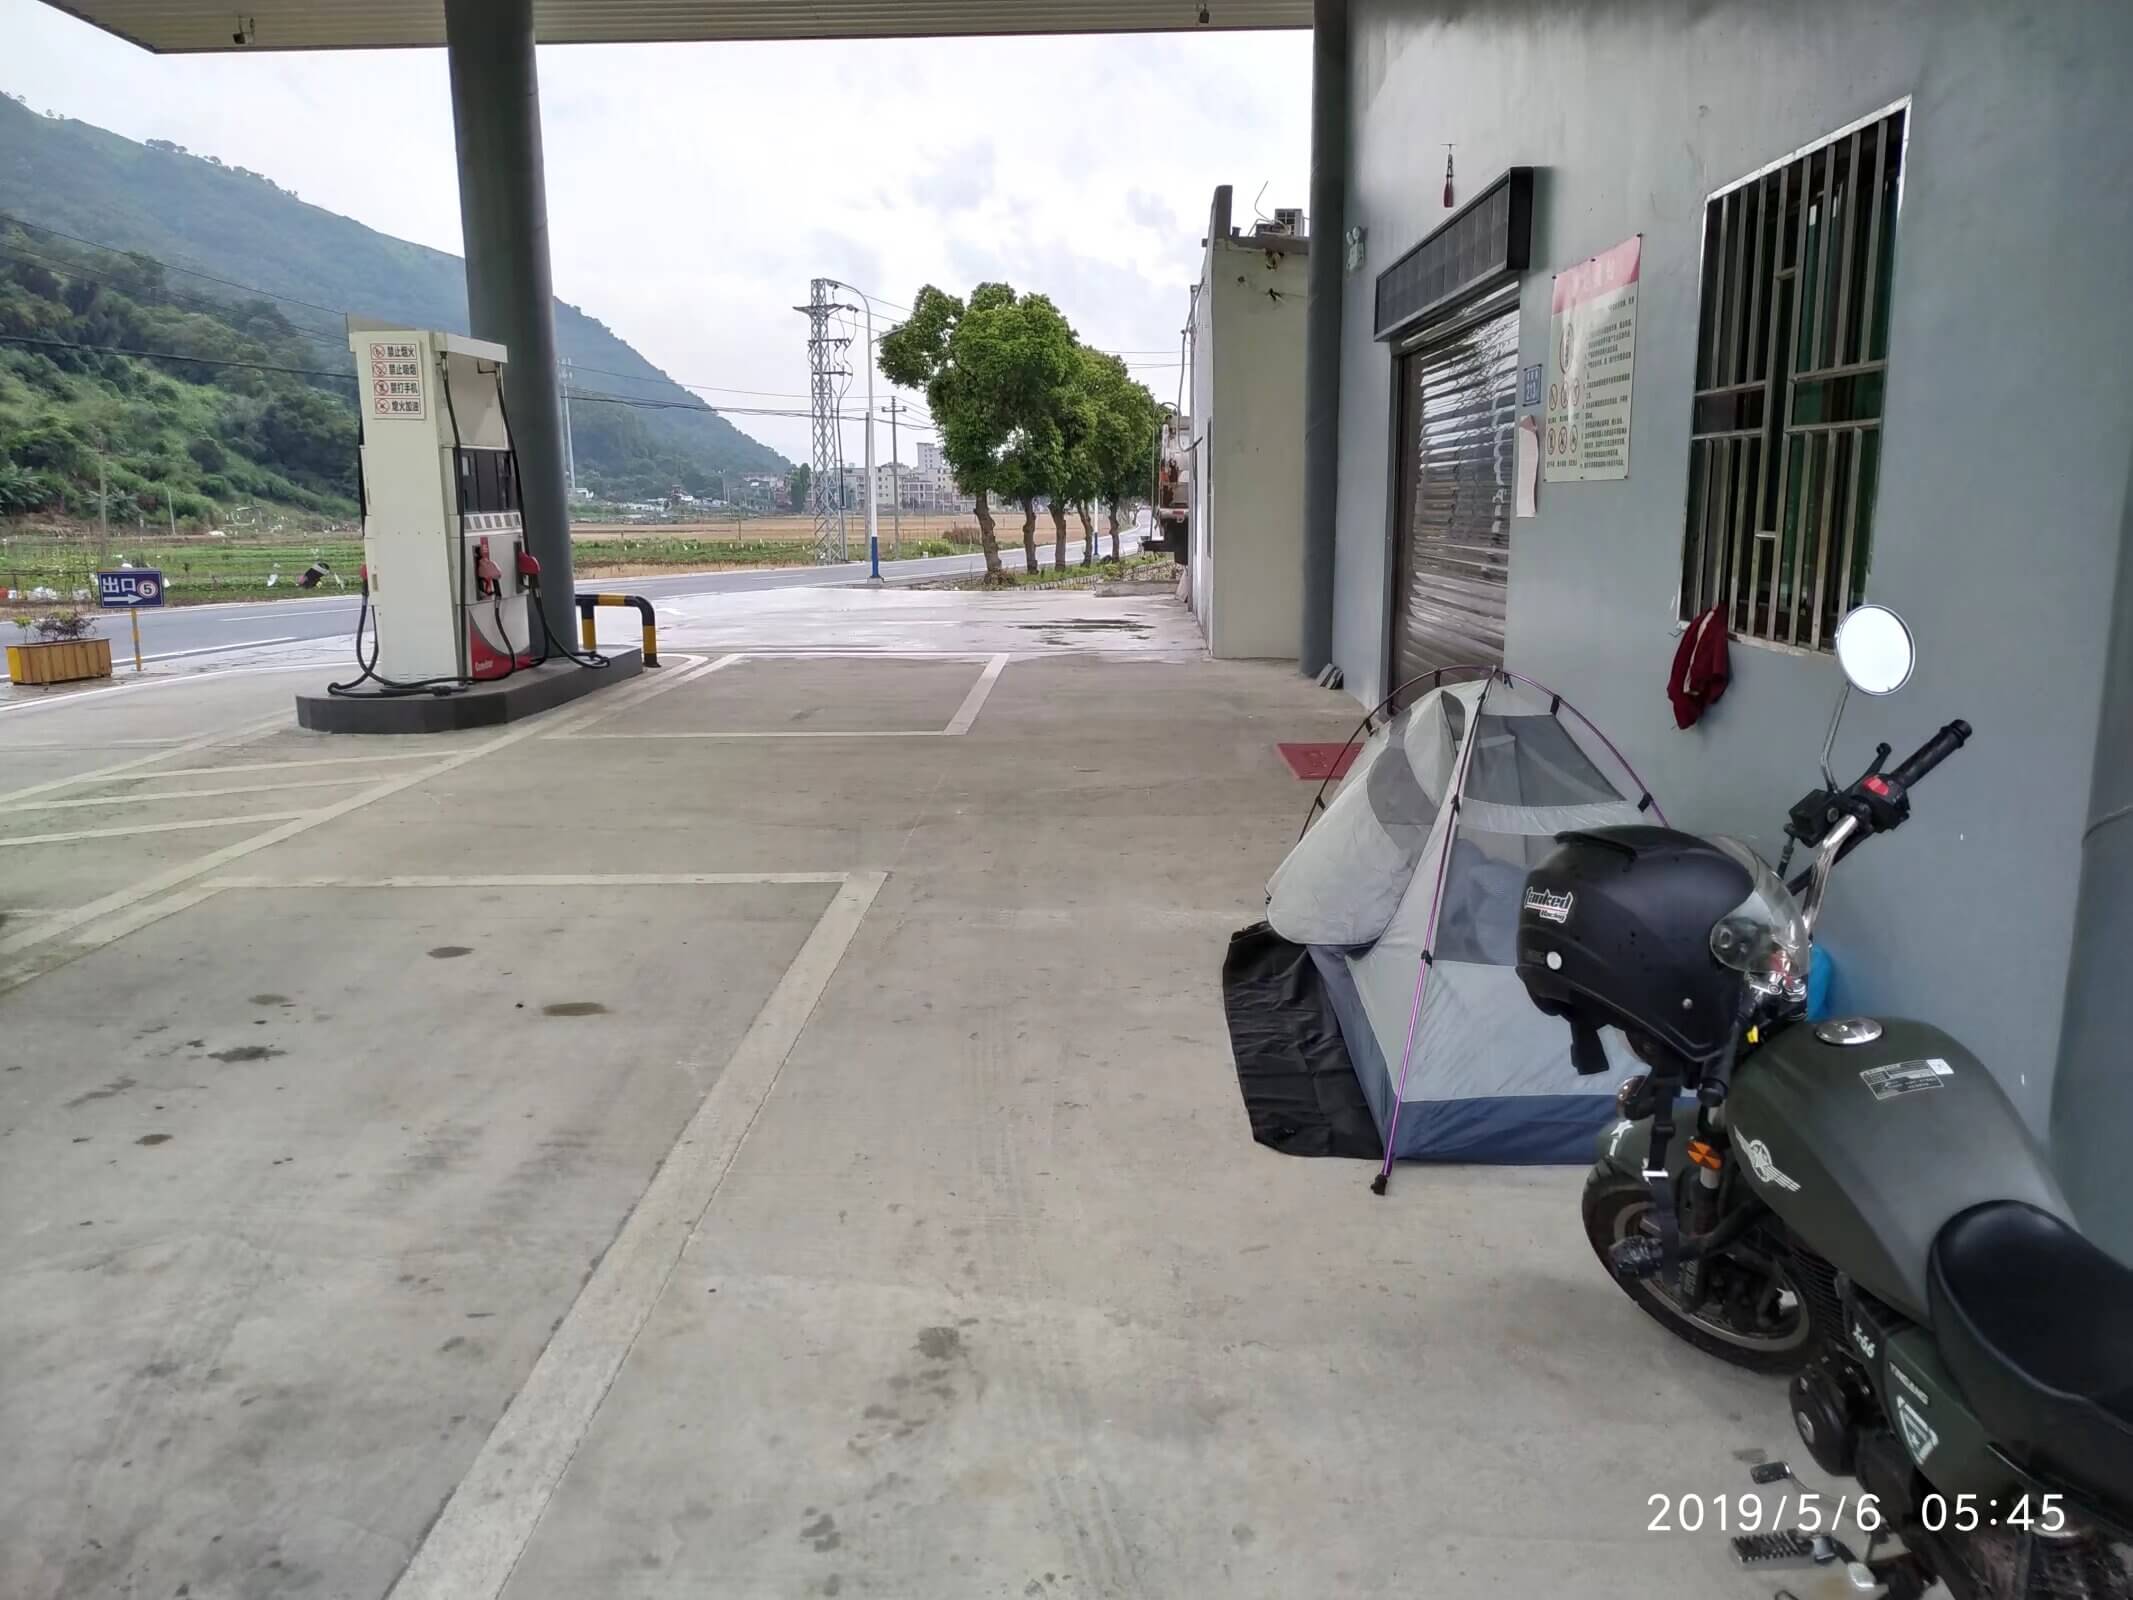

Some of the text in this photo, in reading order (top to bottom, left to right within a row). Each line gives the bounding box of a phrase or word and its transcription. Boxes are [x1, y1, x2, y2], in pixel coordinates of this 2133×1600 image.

[387, 346, 415, 357] 禁止烟火
[389, 364, 416, 375] 禁止吸烟
[103, 576, 152, 594] 出口 5
